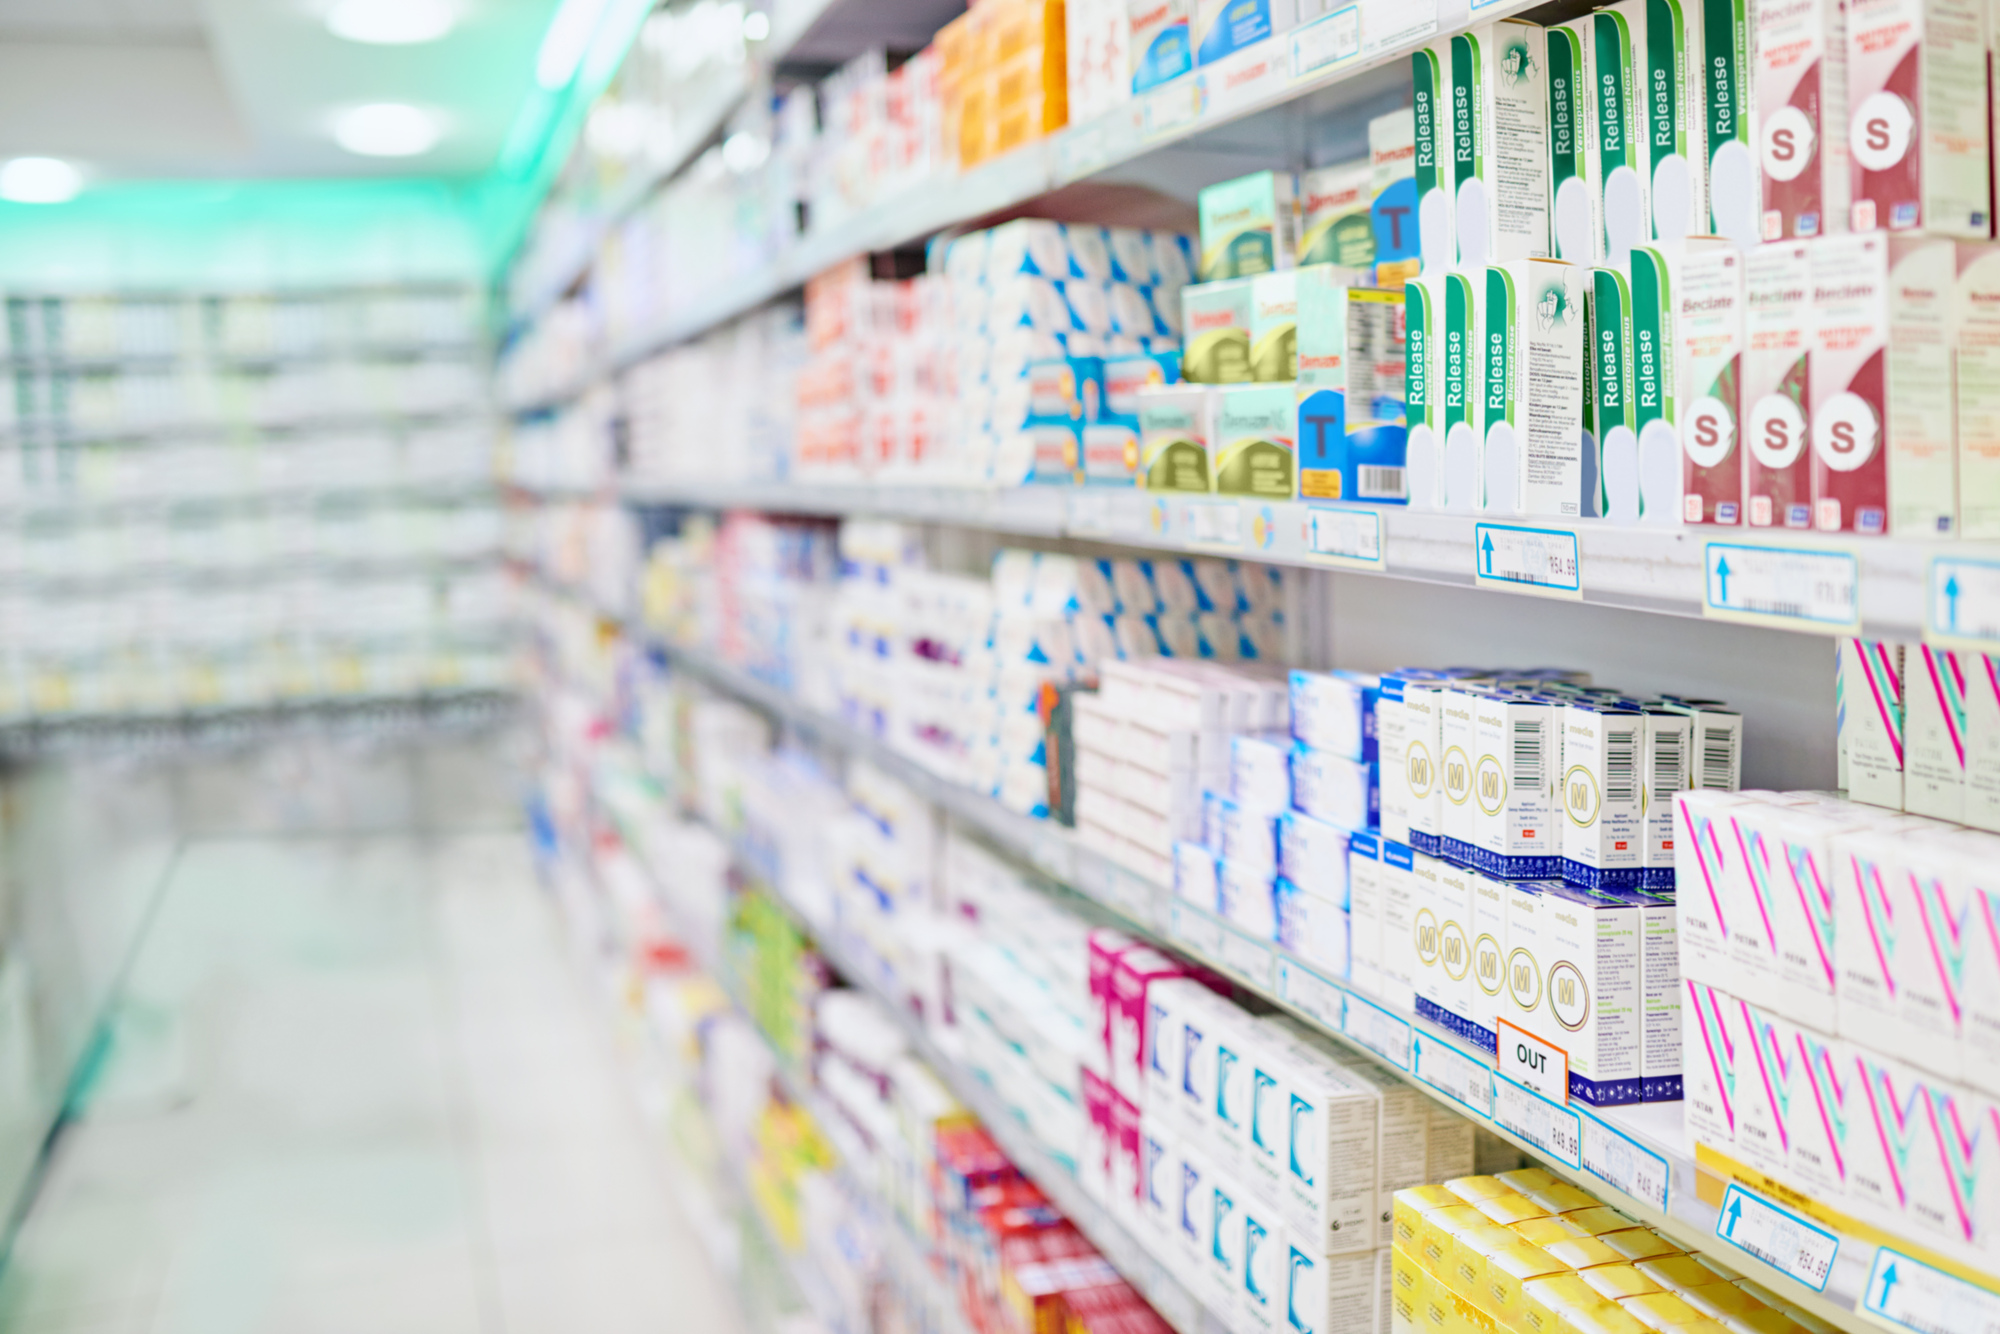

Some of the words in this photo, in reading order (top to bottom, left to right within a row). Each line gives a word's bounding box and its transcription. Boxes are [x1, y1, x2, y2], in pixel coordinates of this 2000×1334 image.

[1654, 69, 1671, 146] Release
[1677, 83, 1685, 131] Blocked
[1714, 57, 1731, 134] Release
[1417, 92, 1433, 167] Release
[1456, 86, 1471, 161] Release
[1554, 78, 1571, 155] Release
[1603, 75, 1620, 151] Release
[1625, 98, 1633, 144] Blocked
[1772, 129, 1795, 161] S
[1866, 118, 1890, 151] S
[1379, 206, 1410, 250] T
[1409, 330, 1423, 405] Release
[1447, 331, 1461, 407] Release
[1489, 333, 1503, 408] Release
[1602, 330, 1619, 407] Release
[1624, 346, 1632, 404] Verstopte
[1640, 330, 1656, 407] Release
[1305, 416, 1336, 458] T
[1695, 415, 1719, 447] S
[1764, 418, 1788, 450] S
[1831, 421, 1855, 454] S
[1550, 556, 1575, 576] R54.99
[1411, 757, 1427, 785] M
[1448, 763, 1464, 791] M
[1482, 771, 1498, 799] M
[1571, 783, 1587, 811] M
[1420, 926, 1435, 954] M
[1445, 937, 1460, 965] M
[1481, 951, 1496, 979] M
[1514, 965, 1530, 993] M
[1558, 978, 1574, 1006] M
[1517, 1043, 1547, 1074] OUT
[1552, 1127, 1578, 1157] R49.99
[1797, 1249, 1828, 1279] R54.99
